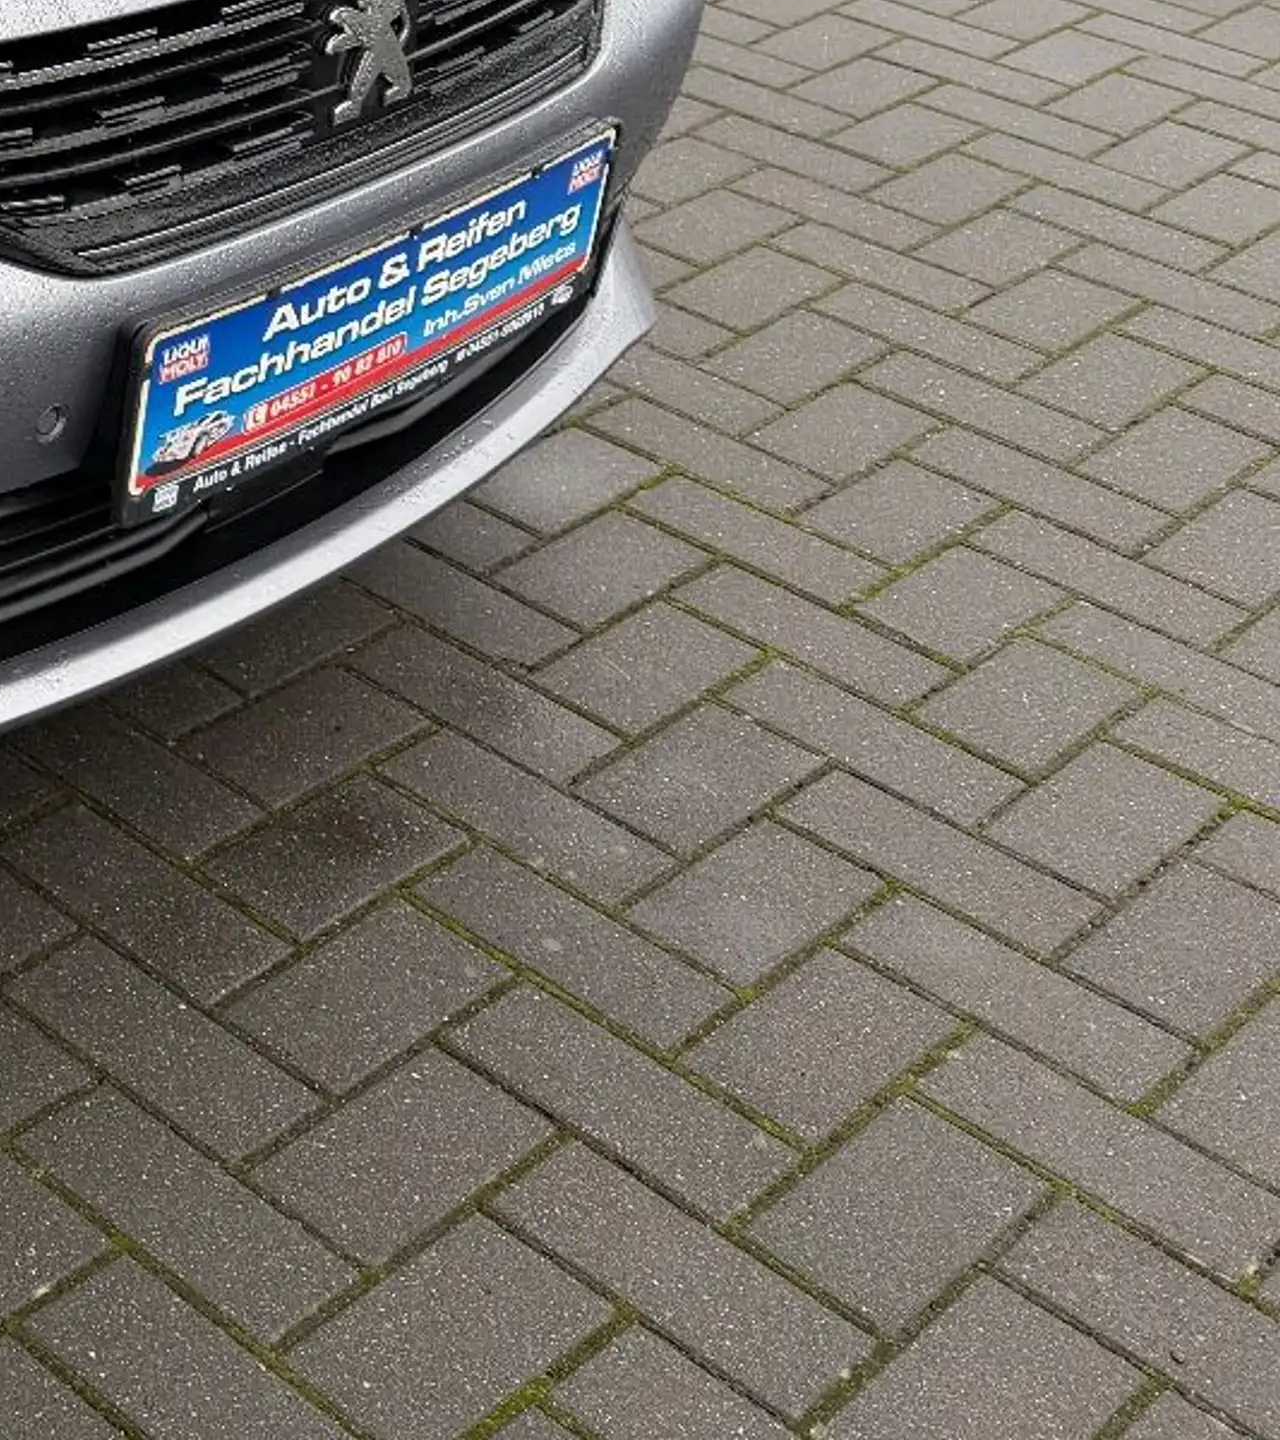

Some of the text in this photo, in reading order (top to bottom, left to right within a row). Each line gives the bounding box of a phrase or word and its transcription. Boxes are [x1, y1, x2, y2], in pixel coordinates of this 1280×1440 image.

[173, 285, 417, 416] Fachhandel
[421, 202, 582, 306] Segeberg
[261, 199, 528, 342] Auto & Reifen
[158, 352, 209, 384] MOLY
[192, 470, 228, 493] Auto
